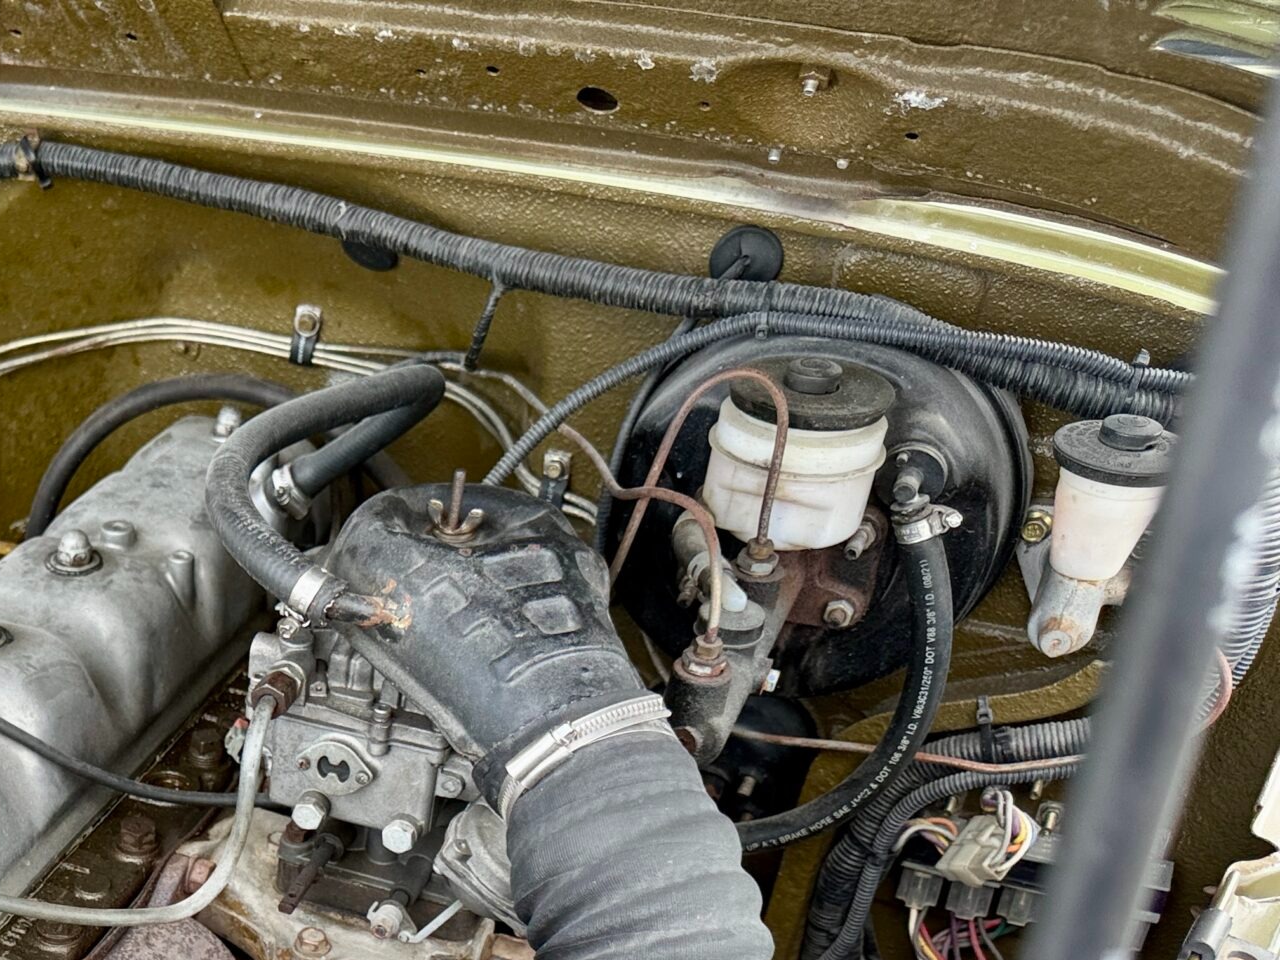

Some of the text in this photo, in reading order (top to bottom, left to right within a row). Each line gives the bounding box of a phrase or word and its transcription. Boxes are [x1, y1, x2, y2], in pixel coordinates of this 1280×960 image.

[926, 626, 936, 644] V88
[925, 646, 936, 664] DOT
[906, 721, 919, 736] I.D.
[889, 752, 902, 766] 106
[875, 766, 892, 783] DOT
[869, 782, 878, 790] &
[832, 804, 852, 819] SAE
[779, 828, 809, 844] BRAKE
